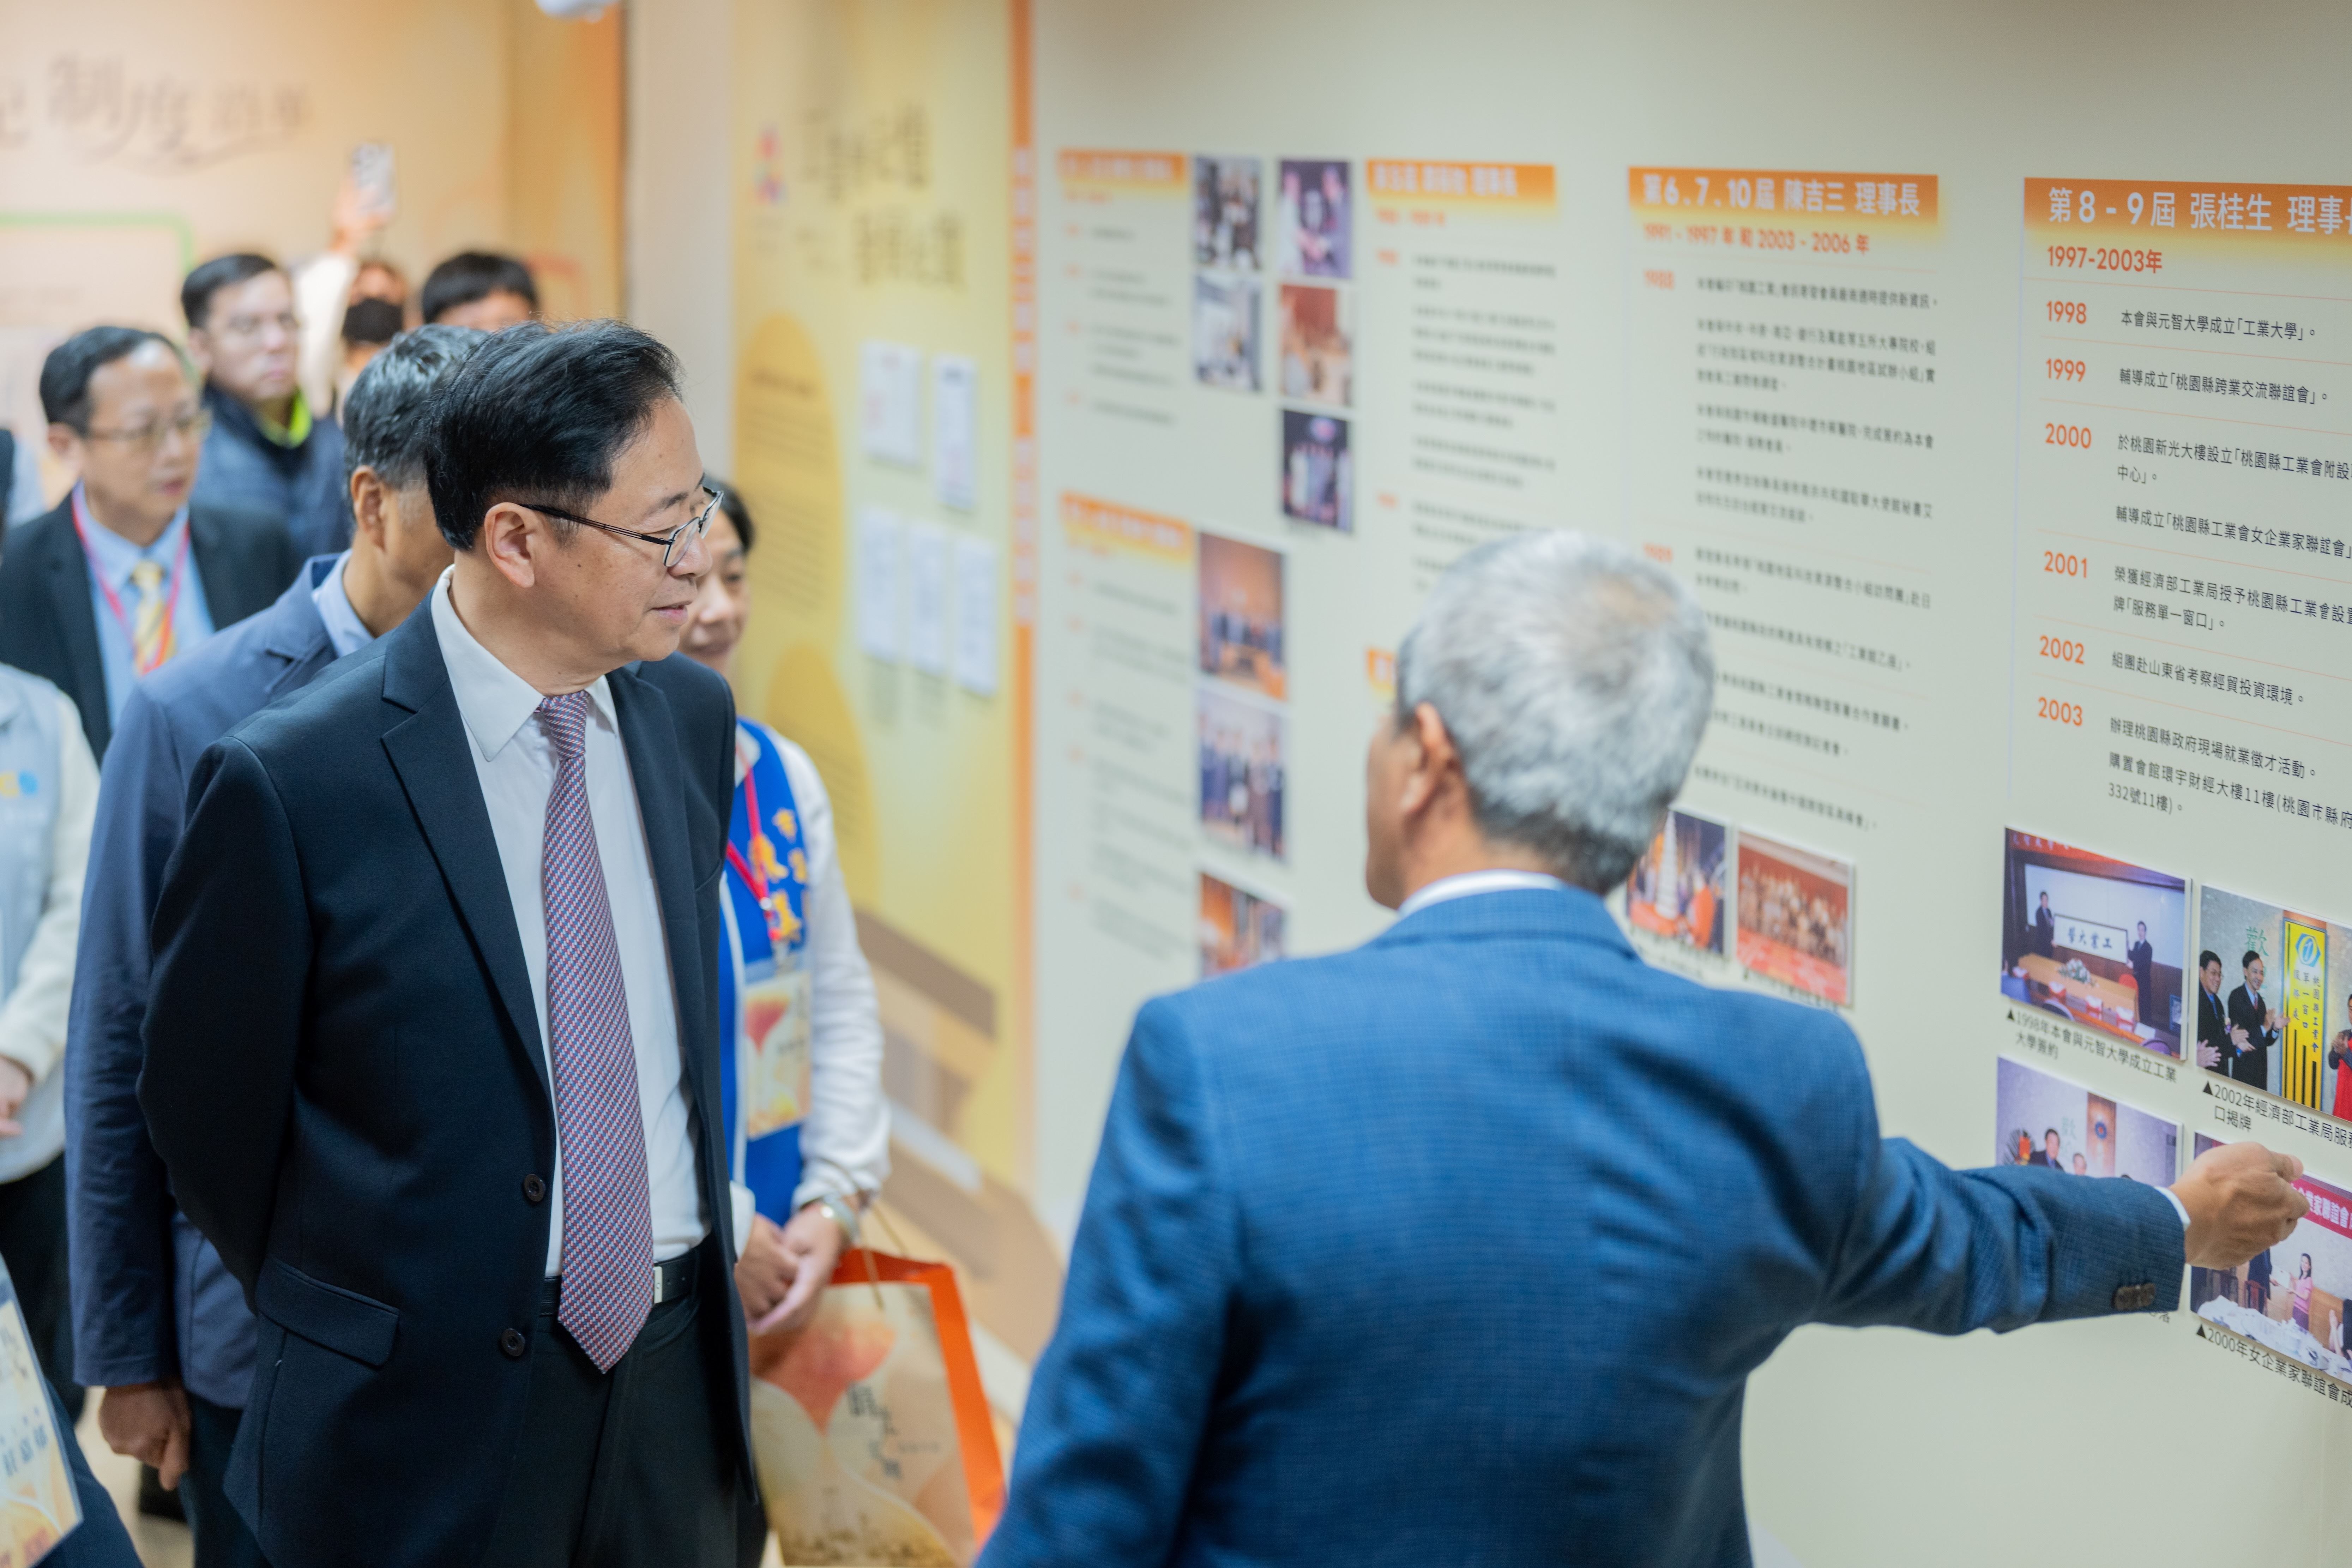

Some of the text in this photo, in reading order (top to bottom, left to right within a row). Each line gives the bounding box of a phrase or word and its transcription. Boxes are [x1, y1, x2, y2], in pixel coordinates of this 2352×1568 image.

[1784, 179, 1845, 212] 陳吉三
[1855, 182, 1920, 216] 理事長
[2190, 193, 2272, 231] 張桂生
[2287, 195, 2352, 235] 理事
[2047, 245, 2162, 273] 1997-2003年
[2046, 301, 2087, 324] 1998
[2121, 309, 2315, 341] 本會與元智大學成立「工業大學」。
[2046, 358, 2086, 382] 1999
[2119, 368, 2327, 404] 輔導成立「桃園縣跨業交流聯誼會」。
[2045, 423, 2091, 449] 2000
[2118, 434, 2352, 480] 於桃園新光大樓設立「桃園縣工業會附設
[2044, 551, 2087, 578] 2001
[2039, 635, 2084, 664] 2002
[2112, 652, 2303, 705] 組團赴山東省考察經貿投資環境。
[2038, 697, 2082, 726] 2003
